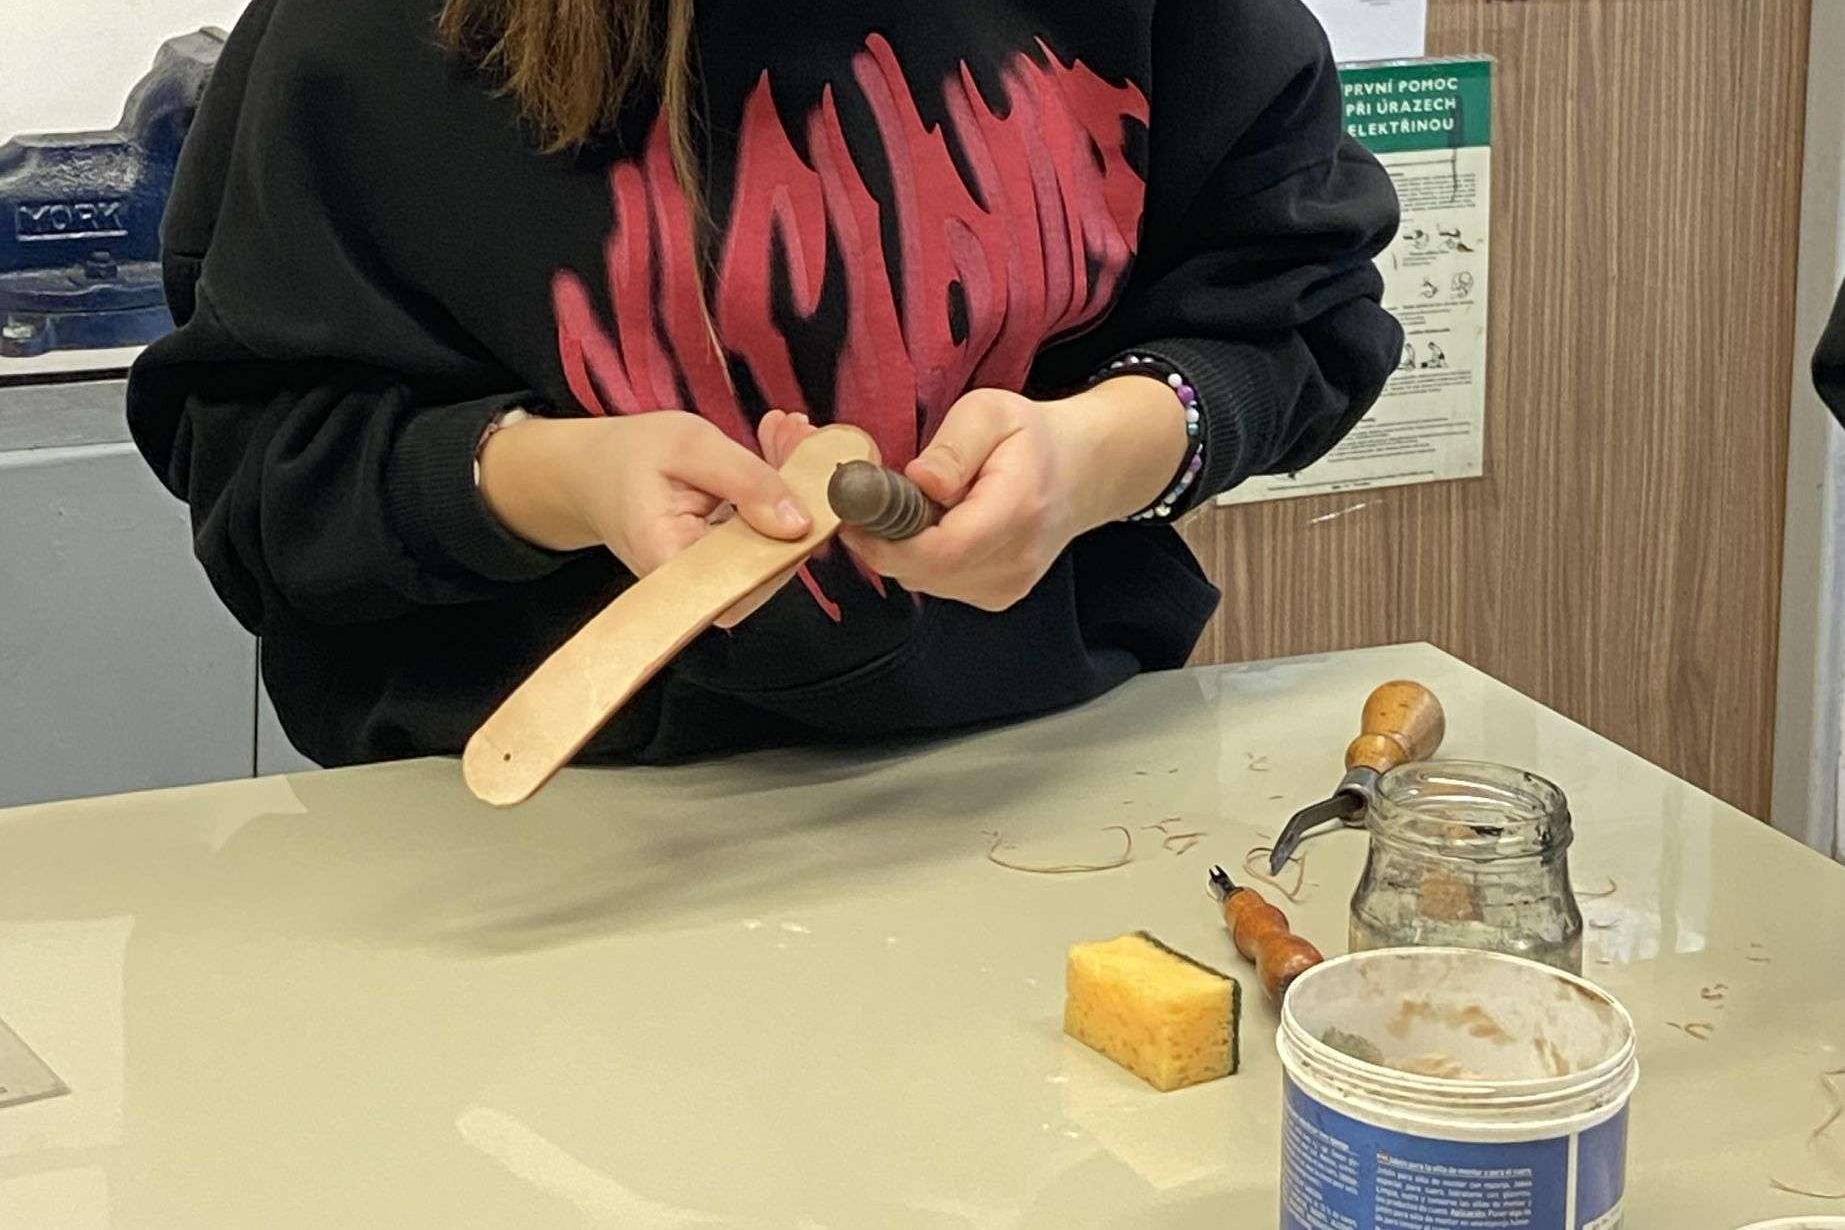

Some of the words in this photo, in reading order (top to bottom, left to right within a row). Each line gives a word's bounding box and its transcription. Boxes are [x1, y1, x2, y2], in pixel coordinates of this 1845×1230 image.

[1344, 78, 1393, 98] PRVNÍ
[1398, 76, 1459, 93] POMOC
[1345, 99, 1372, 118] PŘI
[1376, 97, 1457, 115] ÚRAZECH
[1347, 117, 1455, 138] ELEKTŘINOU
[19, 201, 123, 230] YORK
